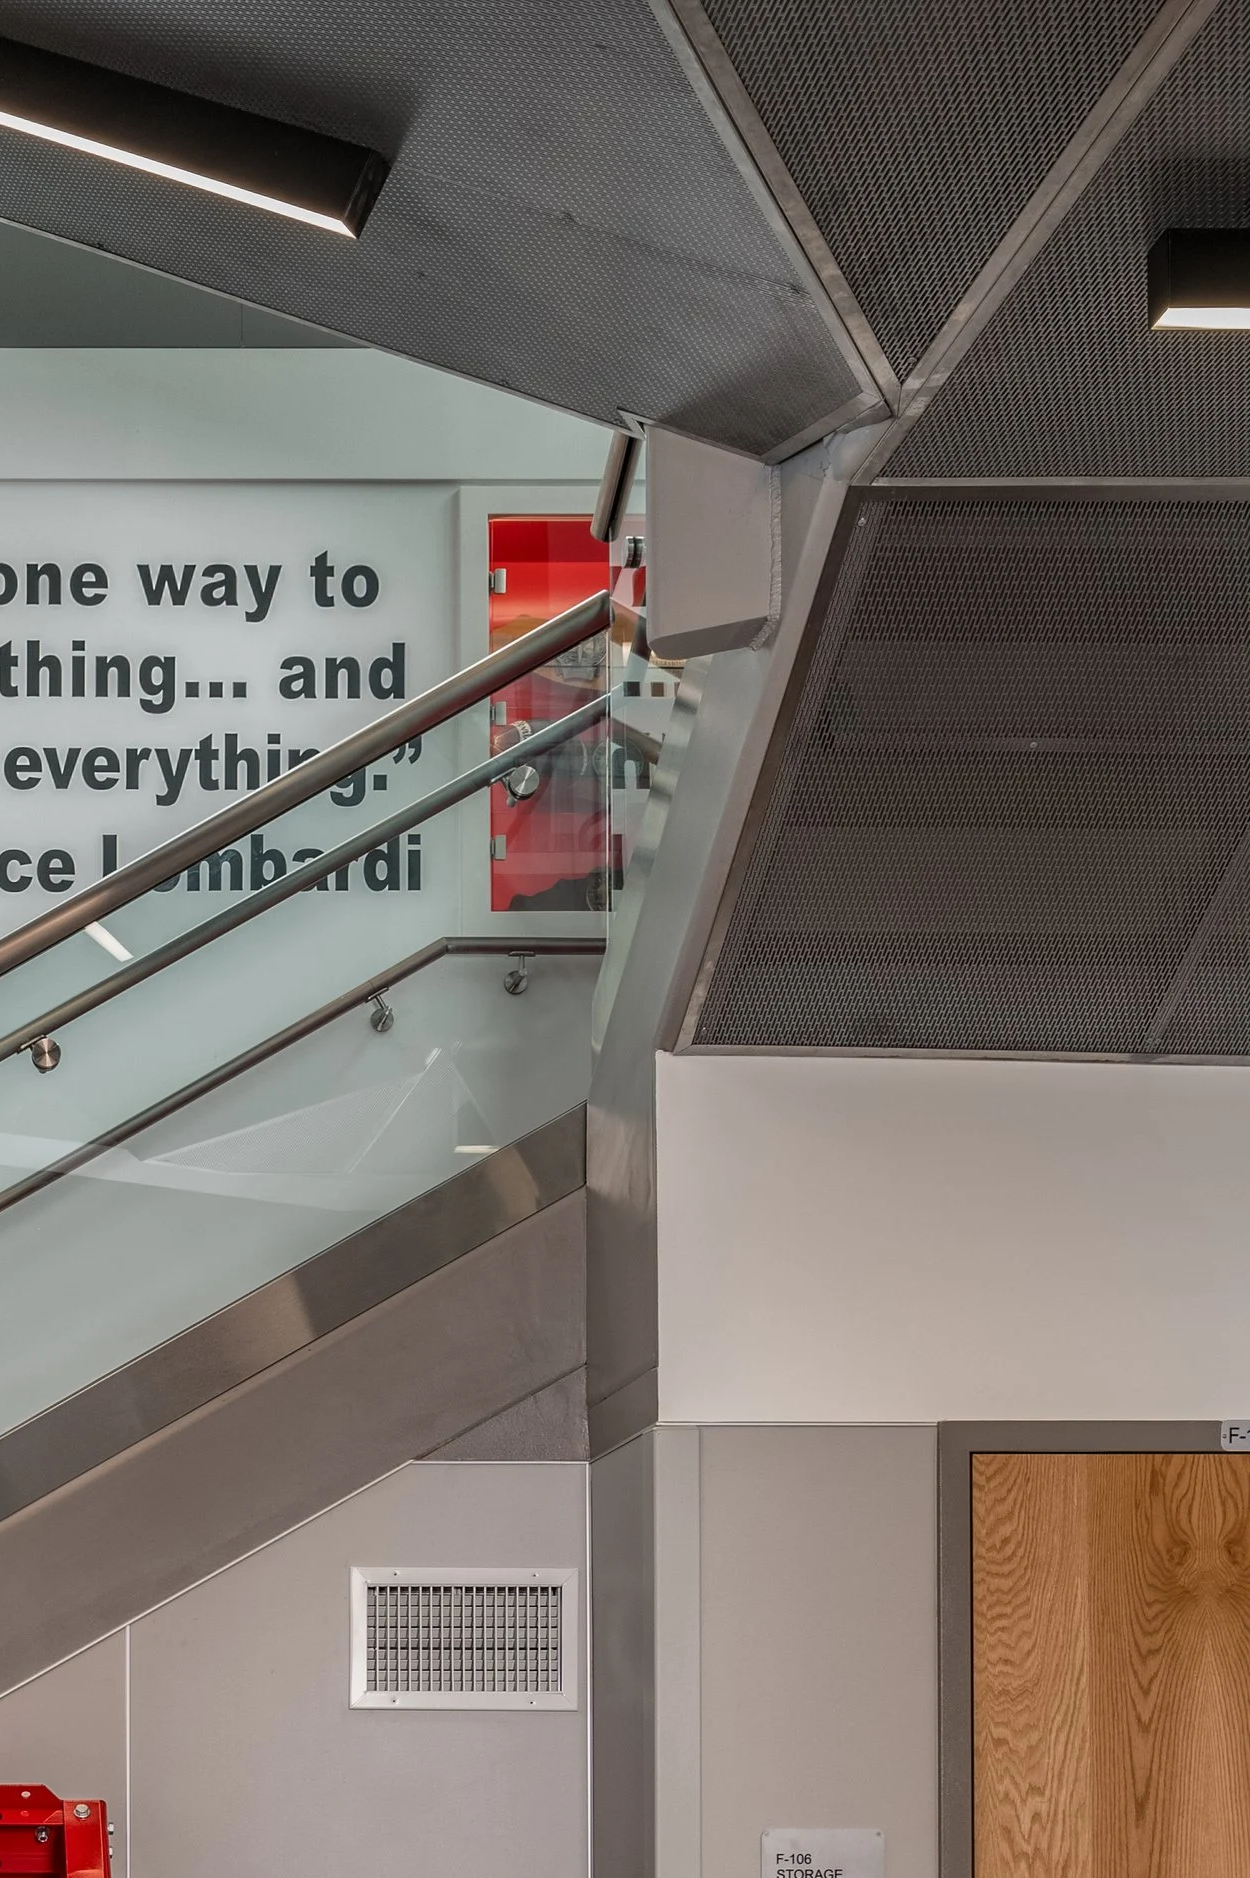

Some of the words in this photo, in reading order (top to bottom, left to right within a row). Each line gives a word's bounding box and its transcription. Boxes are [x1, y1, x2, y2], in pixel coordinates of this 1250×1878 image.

[136, 563, 283, 623] way
[309, 550, 380, 608] to
[278, 642, 406, 701] and
[102, 833, 422, 892] Lmbdi
[1229, 1427, 1250, 1443] F-
[776, 1853, 812, 1865] F-106
